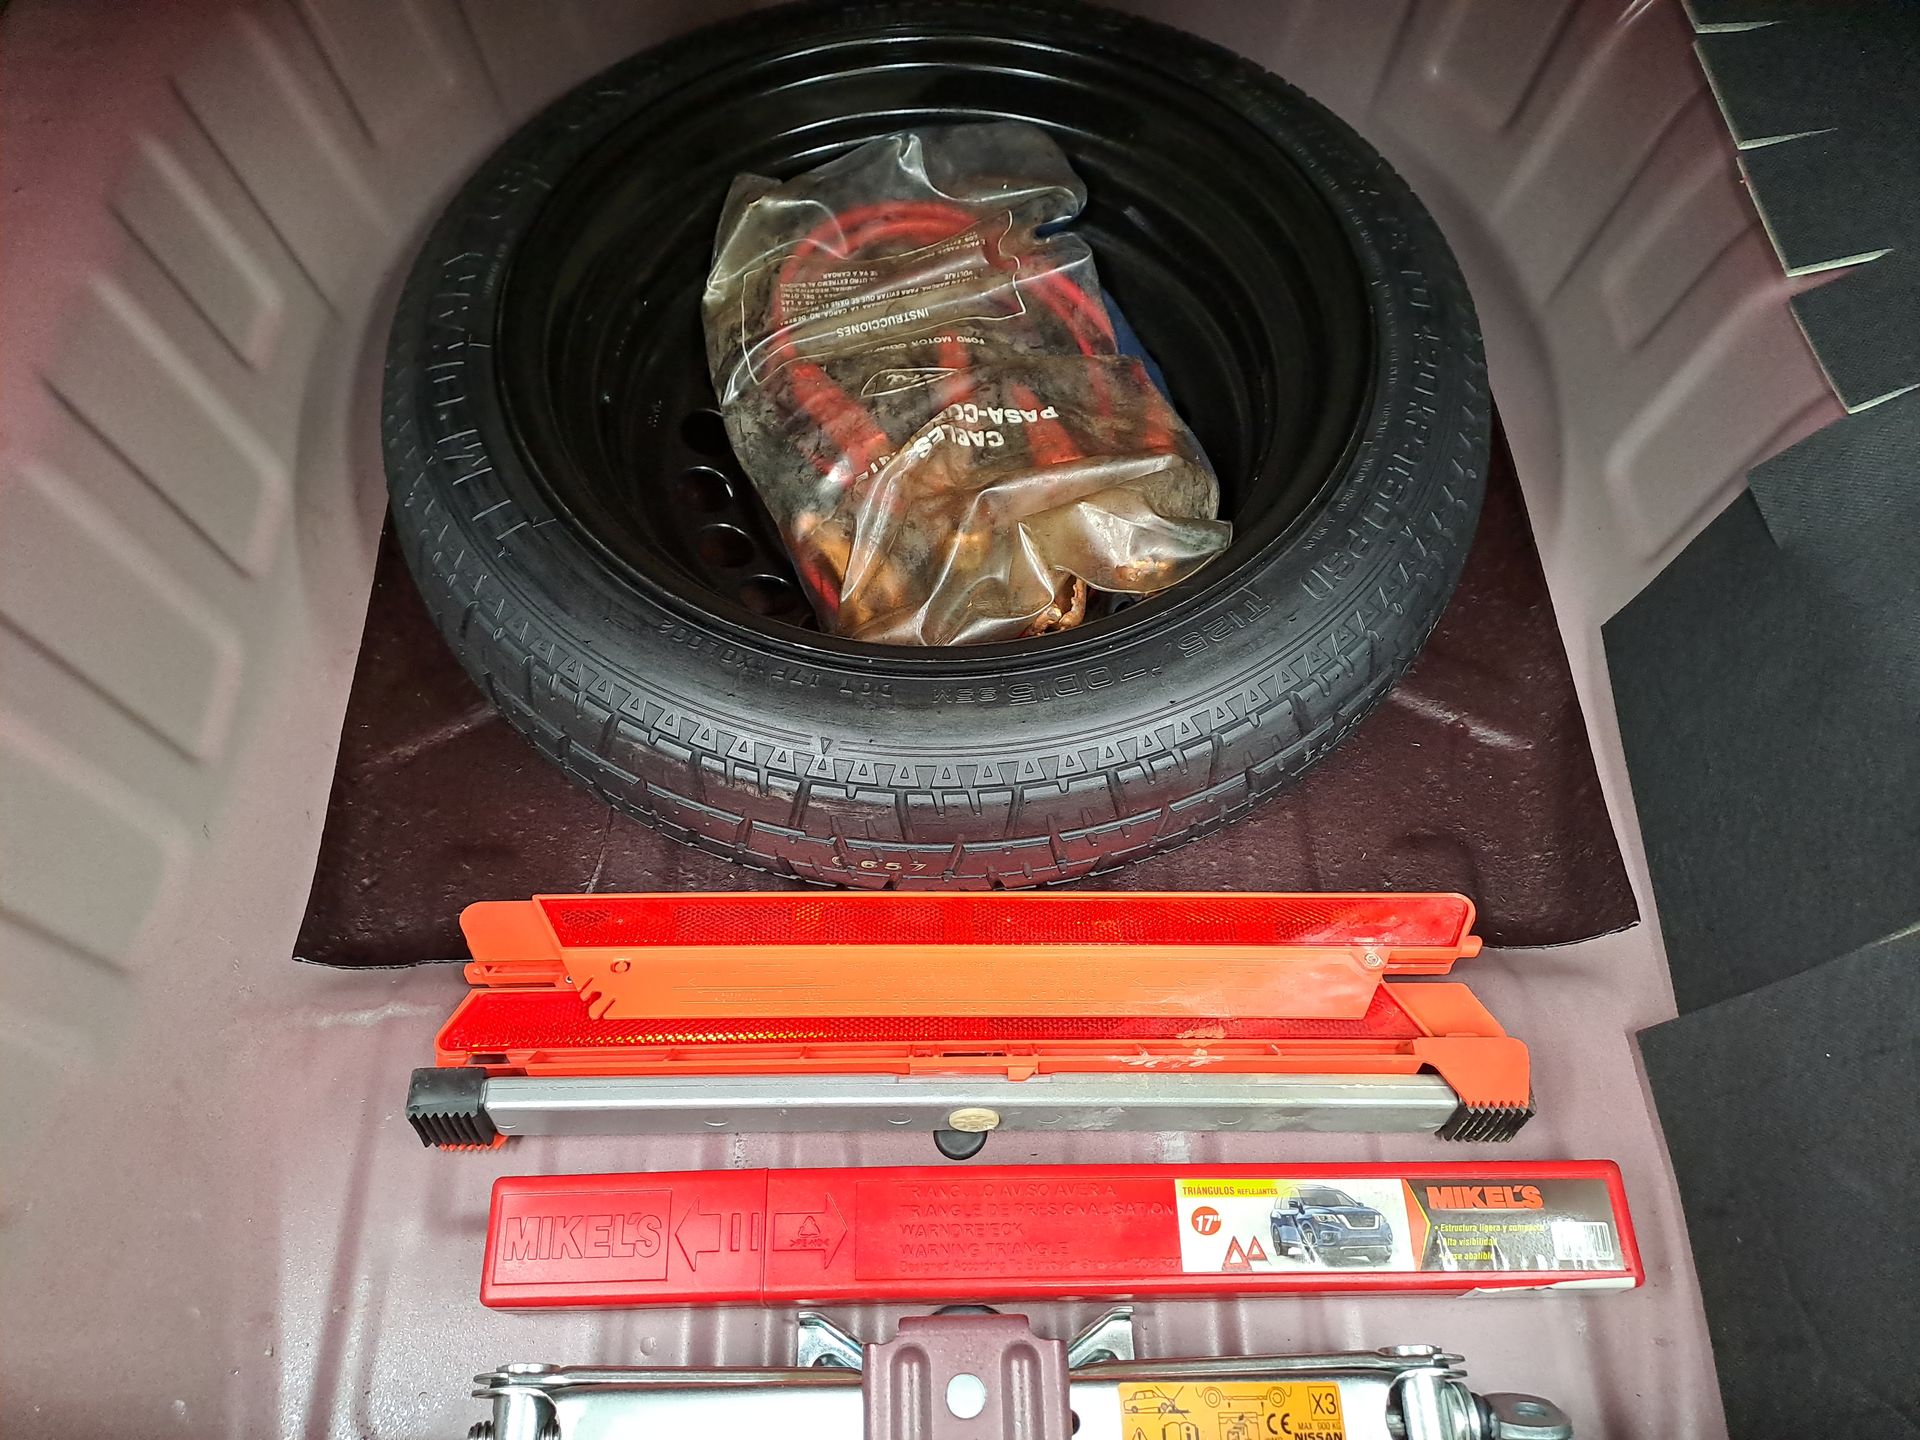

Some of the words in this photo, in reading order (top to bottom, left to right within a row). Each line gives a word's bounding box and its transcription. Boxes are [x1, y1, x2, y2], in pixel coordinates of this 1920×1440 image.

[836, 307, 930, 338] INSTRUCCIONES
[930, 402, 1059, 425] PASA-CO
[1182, 1184, 1235, 1196] TRIÁNGULOS
[1237, 1188, 1279, 1196] REFLEJANTES
[1440, 1223, 1477, 1232] Estructura
[1312, 1392, 1338, 1415] X3
